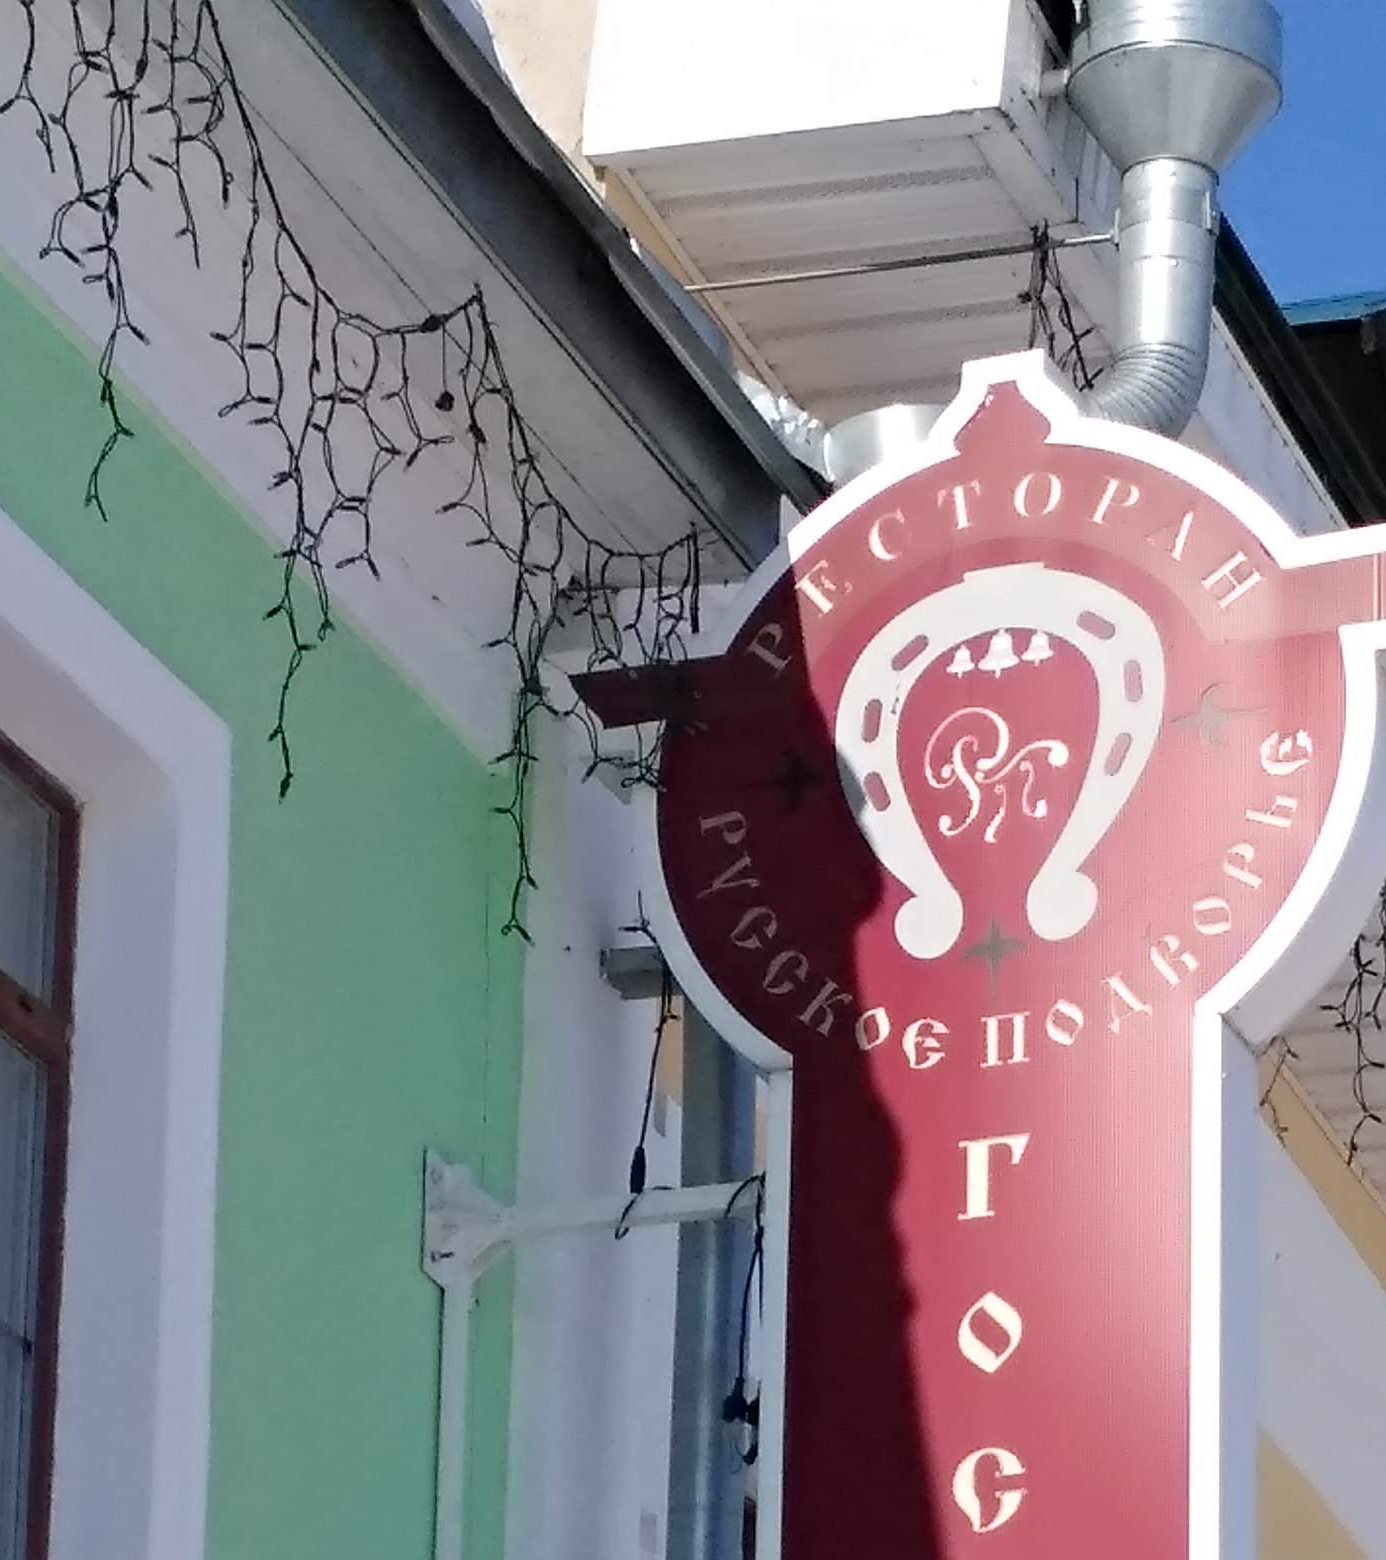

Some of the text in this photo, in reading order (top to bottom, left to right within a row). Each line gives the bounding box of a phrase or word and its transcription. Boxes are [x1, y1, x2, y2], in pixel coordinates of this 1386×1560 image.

[747, 471, 1265, 679] РЕСТОРАН
[696, 727, 1315, 1069] РУССКОЕ ПОДВОРЬЕ
